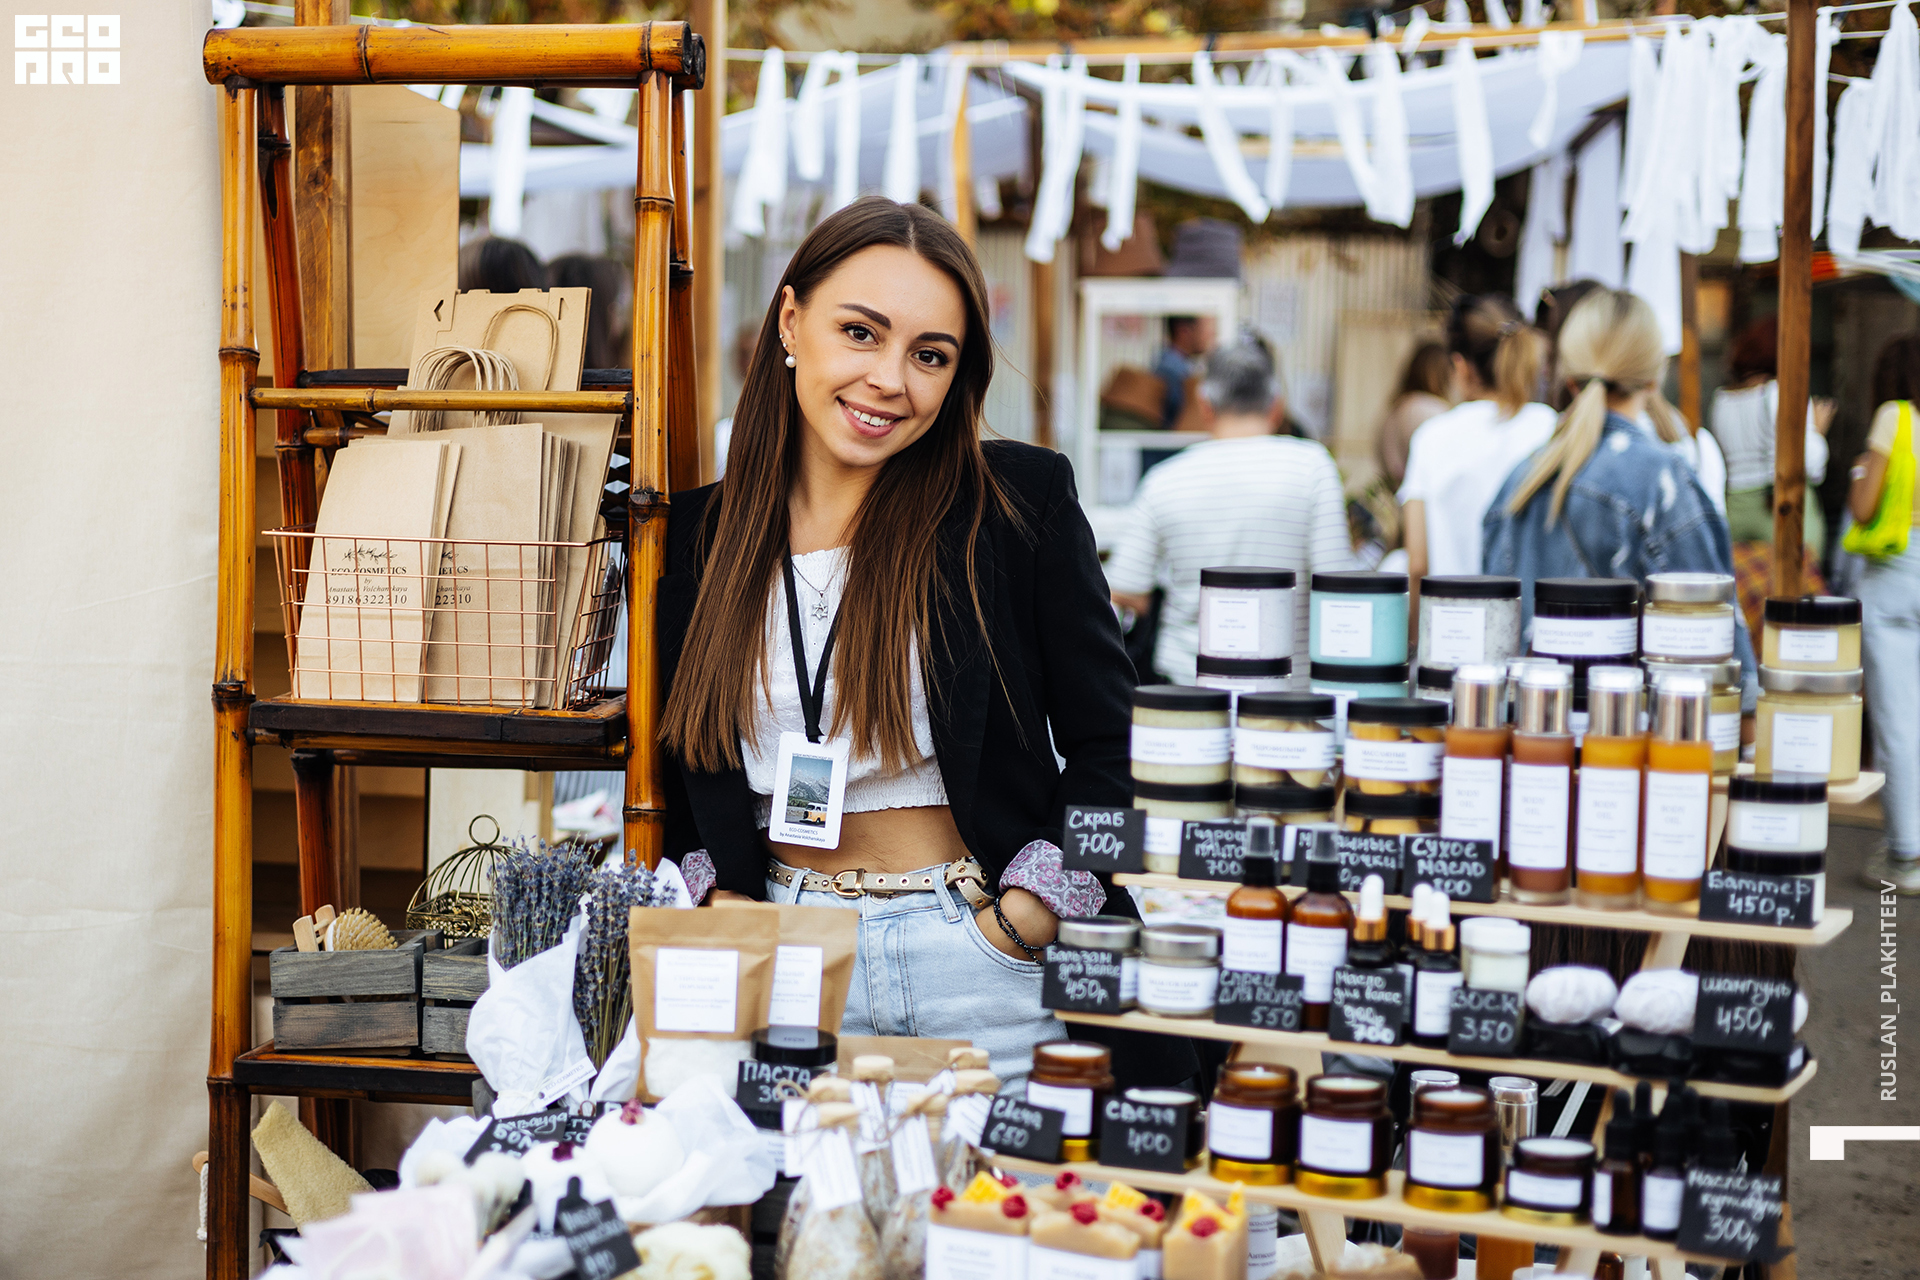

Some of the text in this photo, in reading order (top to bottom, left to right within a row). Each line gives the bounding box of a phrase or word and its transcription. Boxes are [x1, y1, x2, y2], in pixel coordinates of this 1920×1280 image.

[362, 585, 408, 594] Volchankaya
[1069, 810, 1125, 831] Скраб
[1075, 833, 1125, 860] 700р
[1411, 837, 1478, 859] Сухое
[1205, 859, 1243, 875] 700
[1708, 871, 1811, 902] Баттер
[1065, 977, 1109, 1004] 450р
[1251, 1005, 1298, 1029] 550
[1458, 1016, 1515, 1044] 350
[1716, 1005, 1775, 1039] 450р
[743, 1061, 811, 1089] ПАСТА
[1127, 1128, 1173, 1155] 400
